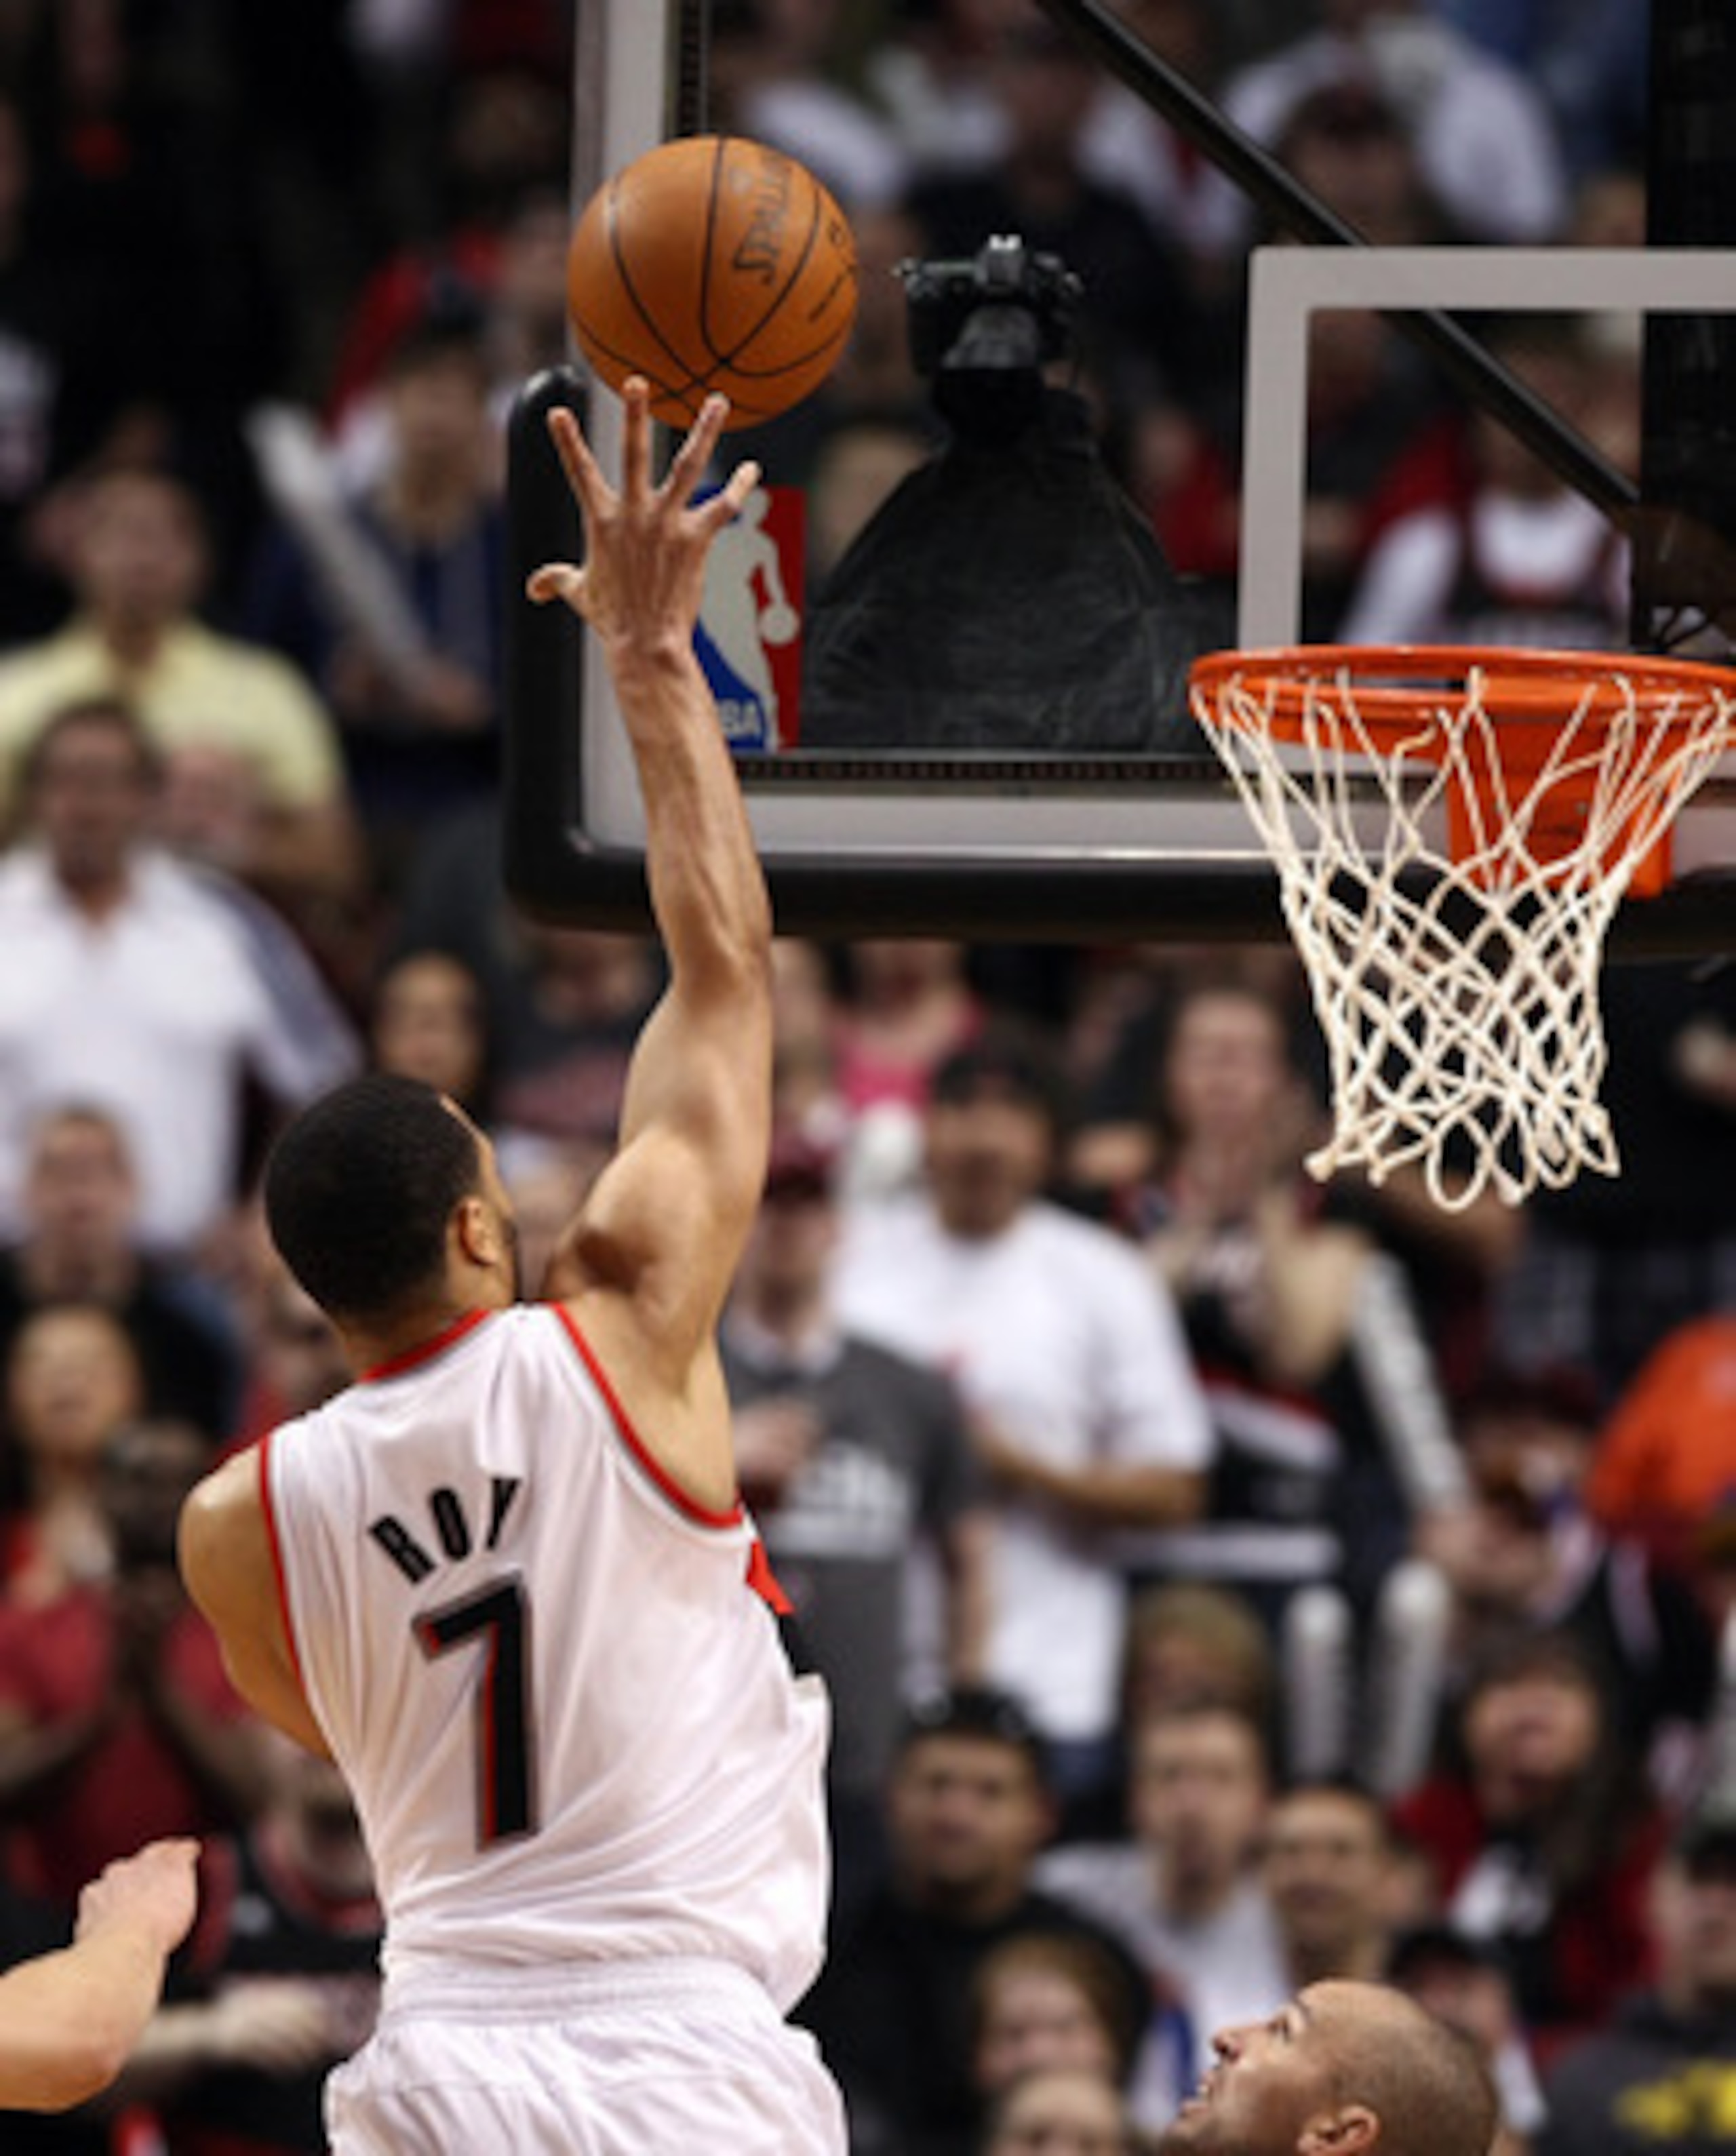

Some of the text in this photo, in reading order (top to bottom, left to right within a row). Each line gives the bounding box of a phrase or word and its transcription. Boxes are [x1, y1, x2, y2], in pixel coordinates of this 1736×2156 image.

[716, 698, 760, 740] BA
[368, 1476, 522, 1585] ROY
[411, 1568, 541, 1853] 7
